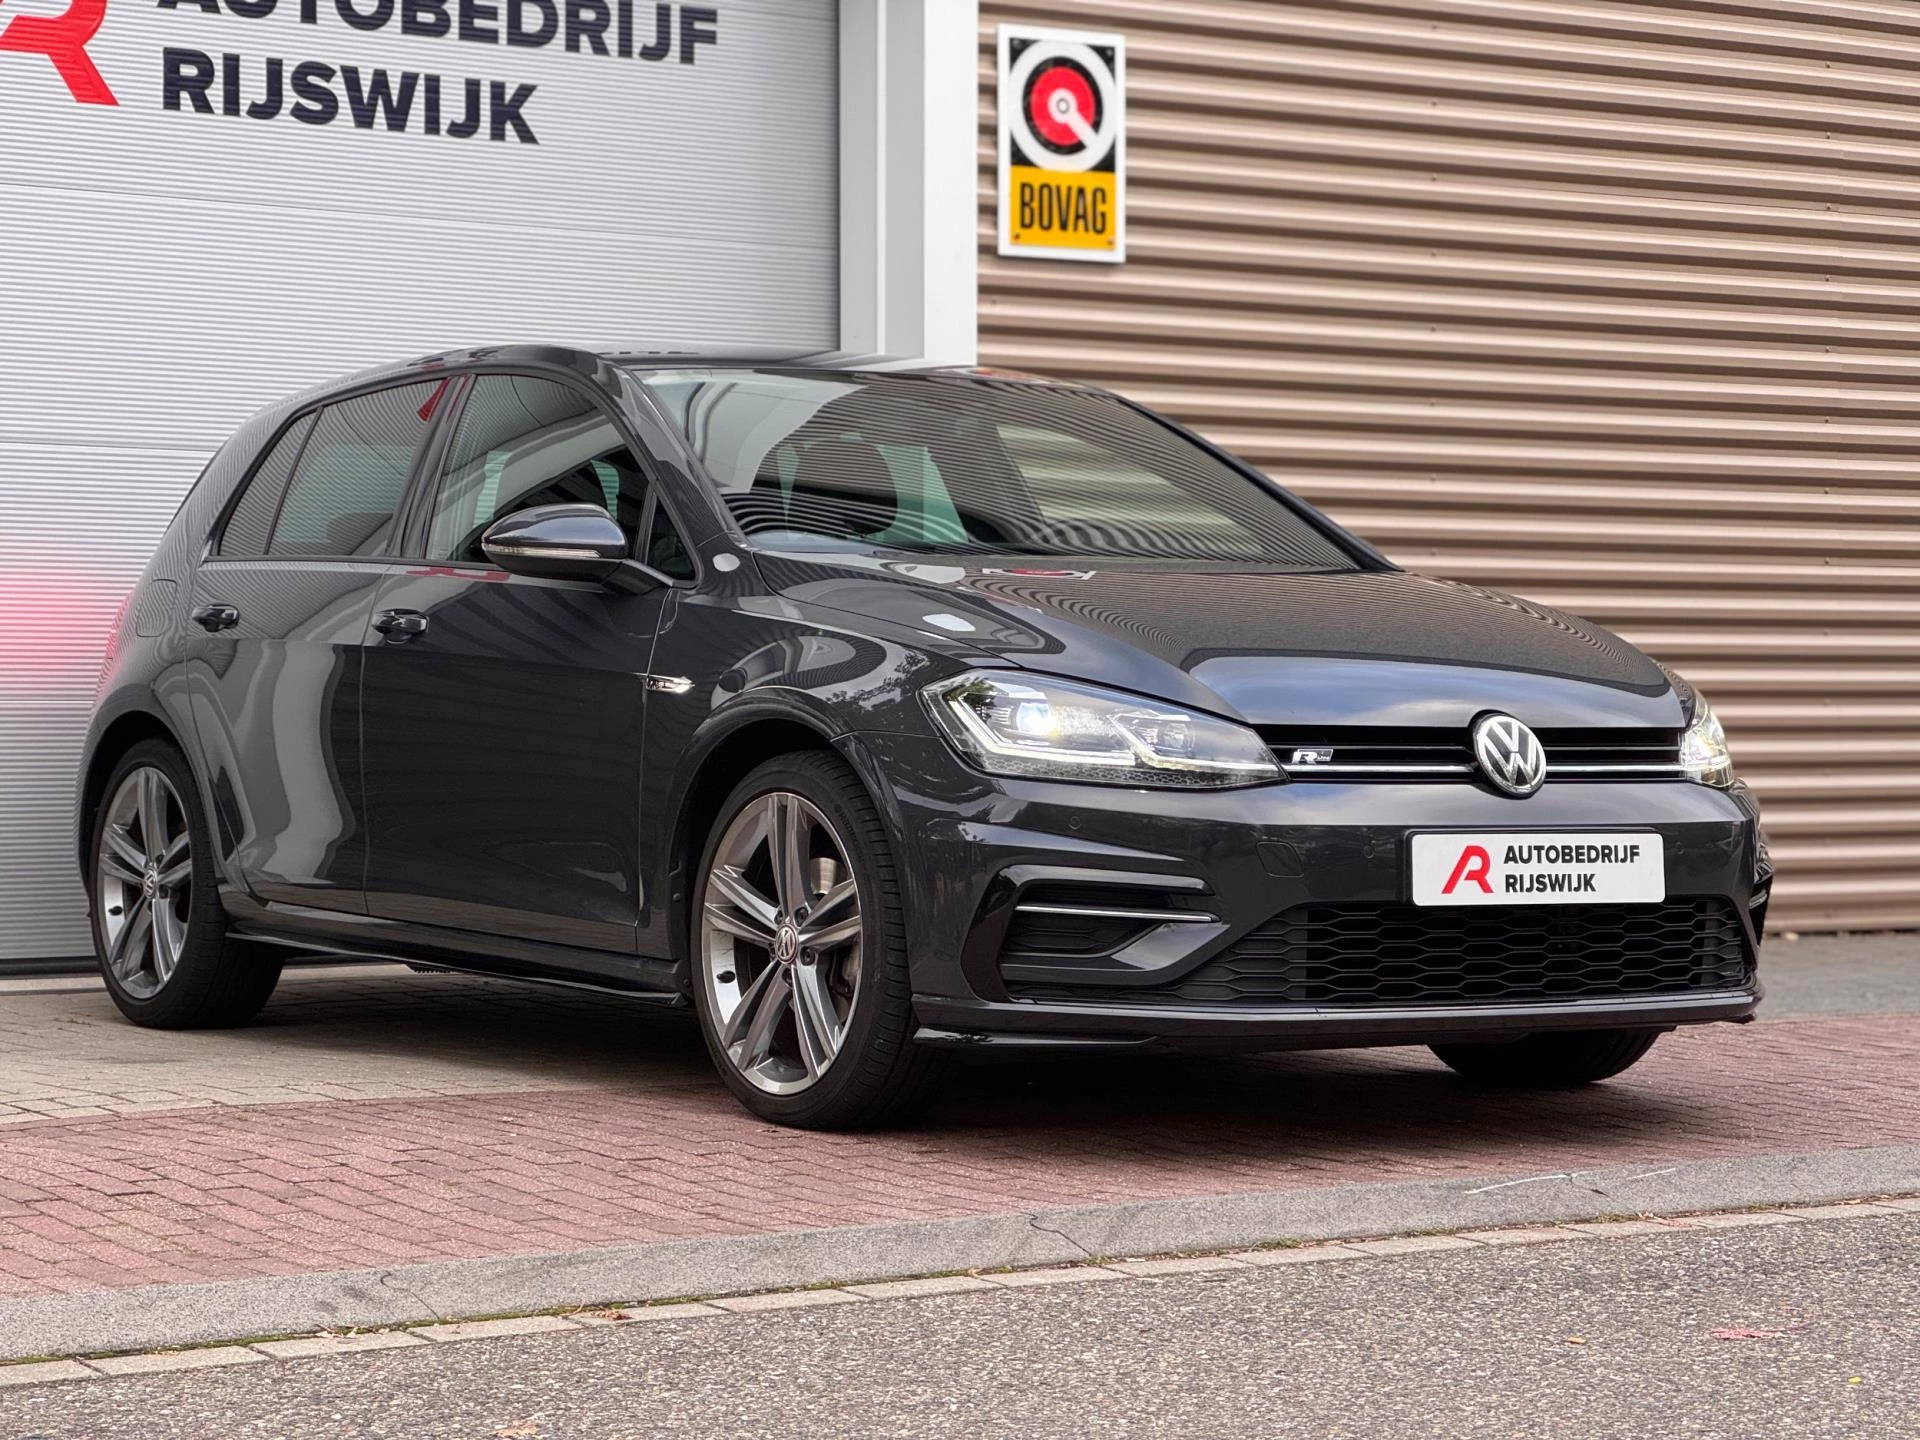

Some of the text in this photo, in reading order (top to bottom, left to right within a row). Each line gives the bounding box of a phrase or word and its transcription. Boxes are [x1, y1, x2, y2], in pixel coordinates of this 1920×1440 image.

[157, 0, 717, 65] BEDRIJF
[163, 47, 540, 145] RIJSWIJK
[1020, 182, 1106, 235] BOVAG
[1504, 845, 1640, 864] AUTOBEDRIJF
[1505, 874, 1596, 893] RIJSWIJK
